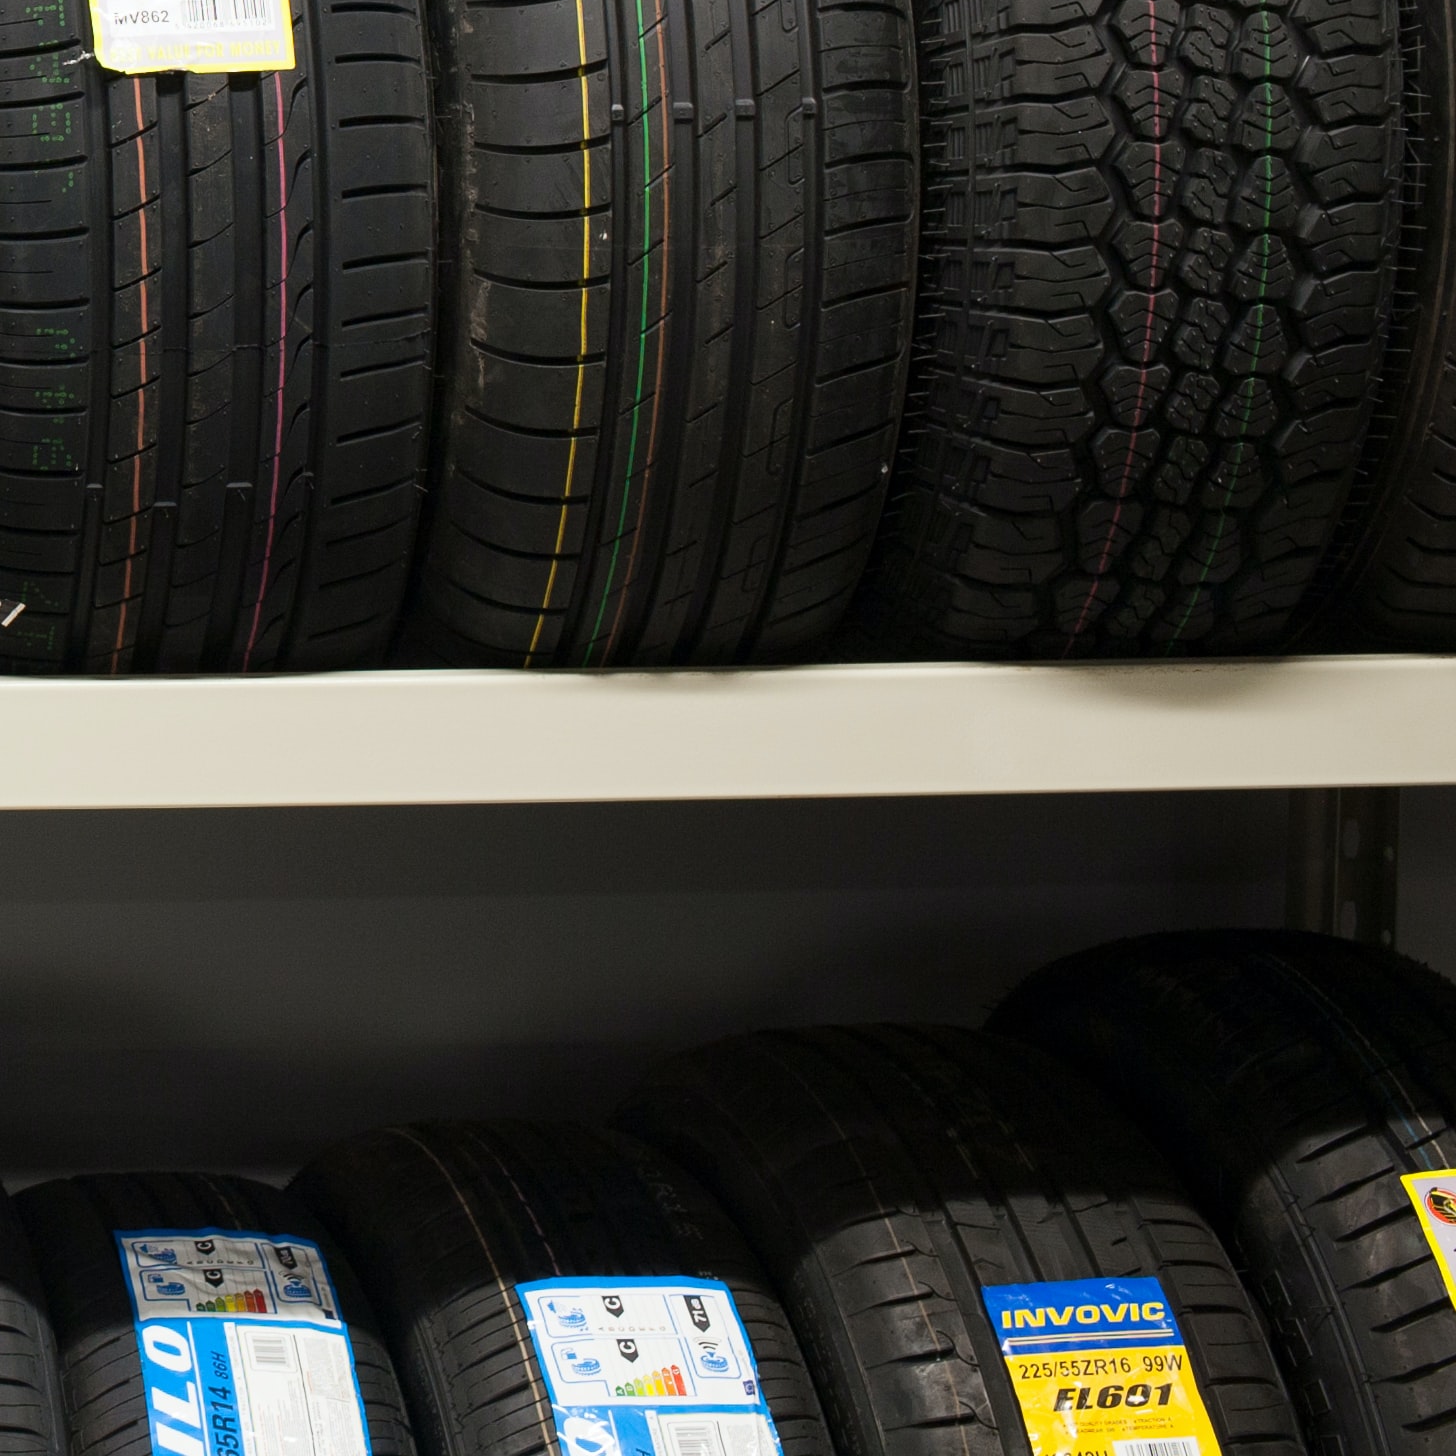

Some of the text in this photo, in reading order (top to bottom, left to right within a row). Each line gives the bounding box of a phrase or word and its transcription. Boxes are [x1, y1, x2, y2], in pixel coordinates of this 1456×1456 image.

[196, 1241, 212, 1253] C
[205, 1270, 222, 1282] C
[605, 1297, 621, 1309] C
[1001, 1302, 1166, 1329] INVOVIC
[619, 1341, 636, 1353] C
[214, 1351, 229, 1380] 86H
[1019, 1354, 1183, 1380] 225/55ZR16 99W
